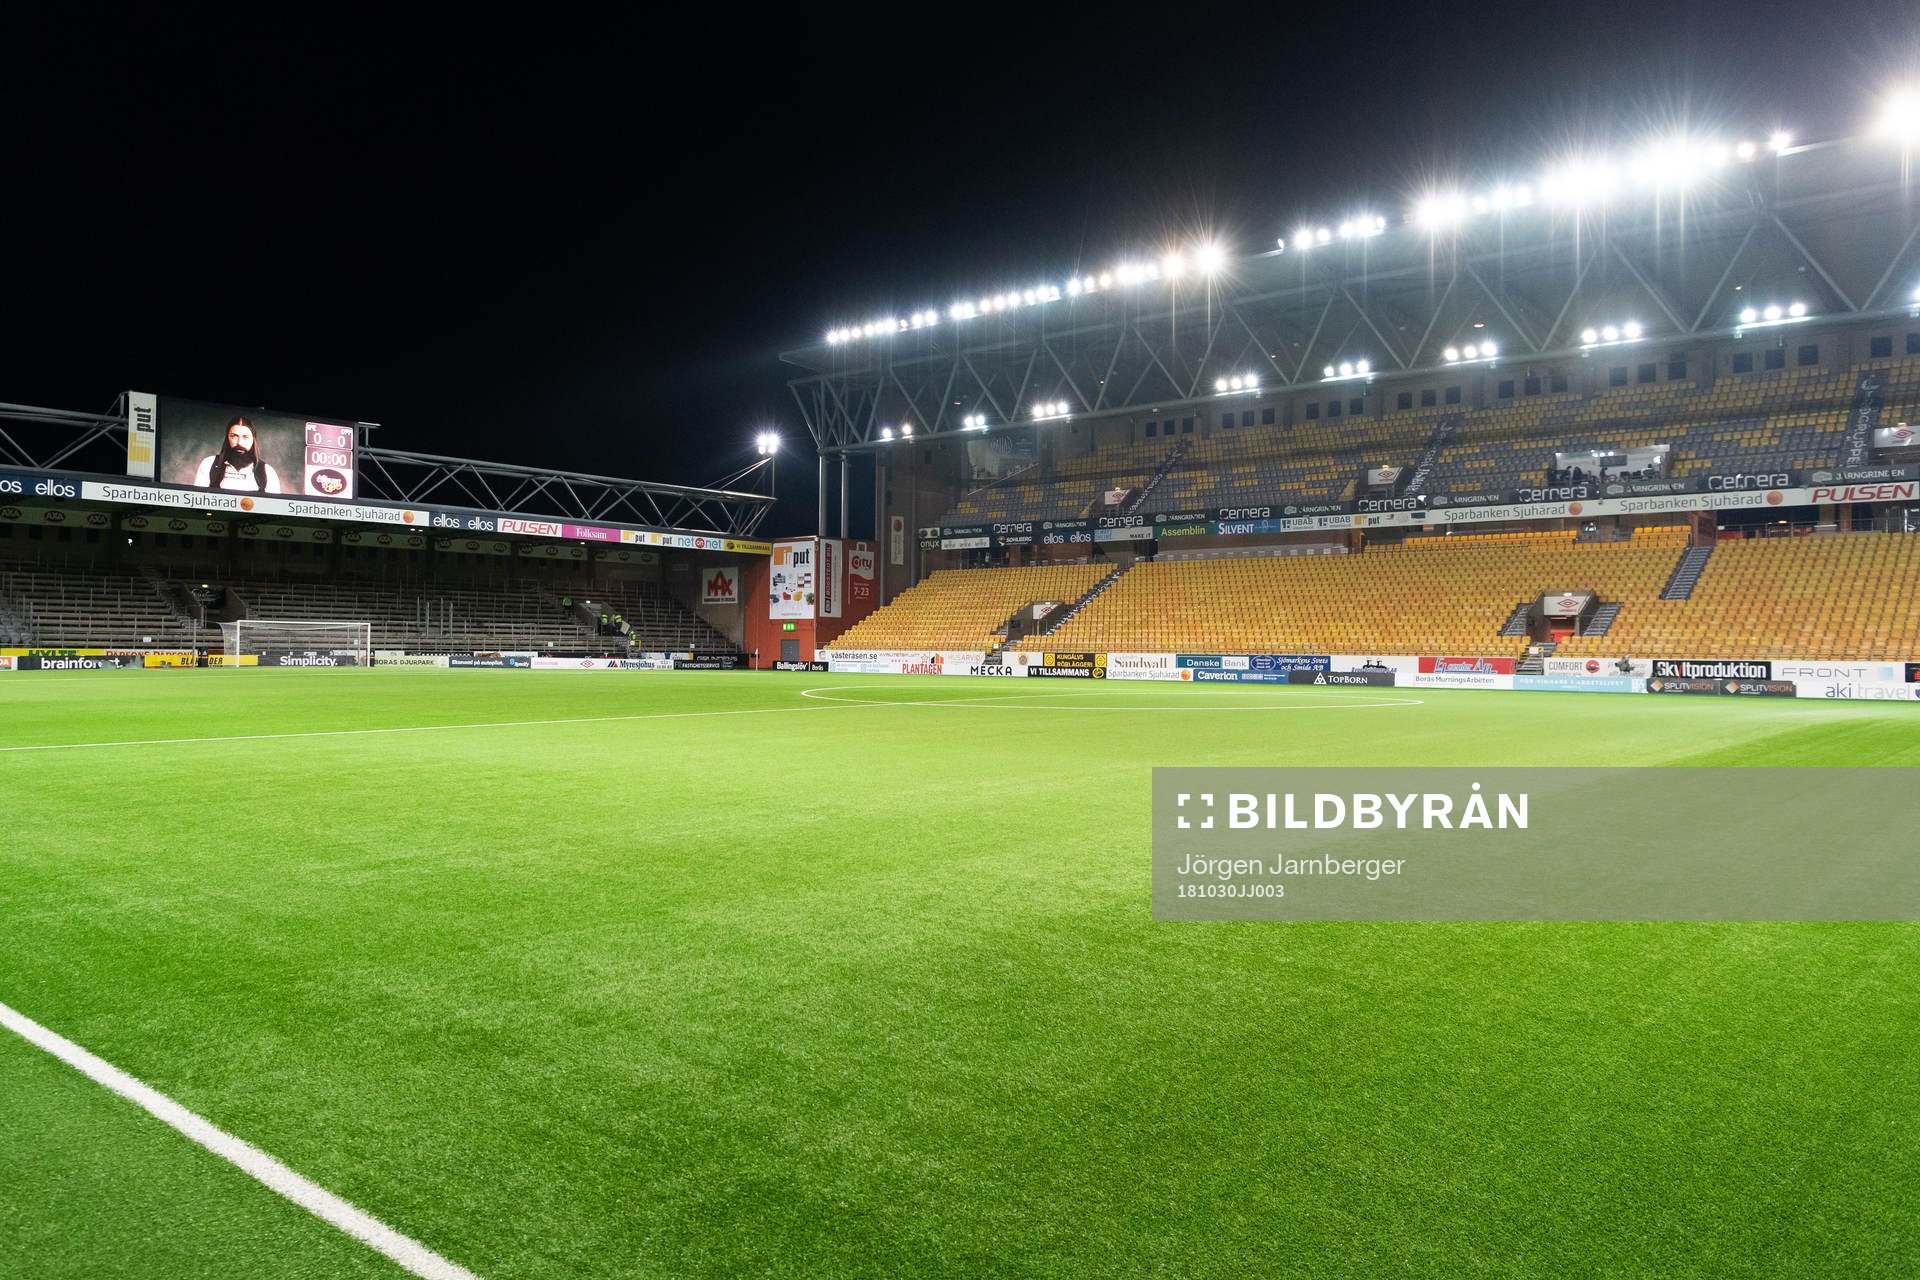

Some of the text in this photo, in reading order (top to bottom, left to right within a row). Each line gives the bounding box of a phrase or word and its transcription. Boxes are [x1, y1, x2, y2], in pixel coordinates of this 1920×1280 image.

[314, 432, 322, 445] 0
[337, 436, 345, 447] 0
[311, 451, 347, 466] 00:00
[35, 479, 76, 498] ellos
[1812, 483, 1914, 503] PULSEN
[102, 485, 237, 508] Sparbanken Sjuhärad
[1620, 493, 1763, 512] Sparbanken Sjuhärad
[288, 501, 400, 521] Sparbanken Sjuhärad
[1444, 504, 1565, 521] Sparbanken Sjuhärad
[433, 513, 460, 528] ellos
[468, 516, 494, 531] ellos
[1329, 516, 1351, 524] UBAB
[501, 520, 558, 536] PULSEN
[576, 527, 607, 539] Folksam
[1161, 526, 1206, 537] Assemblin
[1218, 522, 1255, 535] SILVENT
[1043, 533, 1064, 545] ellos
[1070, 531, 1091, 543] ellos
[920, 540, 940, 549] onyx
[851, 555, 872, 570] City
[707, 570, 733, 597] MAX
[853, 587, 870, 596] 7-23
[280, 656, 338, 667] Simplicity.
[831, 652, 878, 660] västeråsen.se
[620, 660, 655, 670] Myresjöhus
[902, 663, 943, 675] PLANTAGEN
[1114, 657, 1167, 669] Sandwall
[1186, 659, 1220, 667] Danske
[1224, 659, 1247, 667] Bank
[1548, 661, 1583, 671] COMFORT
[970, 666, 1013, 676] MECKA
[1038, 667, 1090, 677] TILLSAMMANS
[1108, 670, 1180, 680] Sparbanken Sjuhärad
[1197, 671, 1238, 681] Caverion
[1656, 661, 1767, 679] Skyltproduktion
[1782, 667, 1868, 678] FRONT
[1740, 684, 1793, 692] SPLITVISION
[1825, 682, 1911, 699] aki travel
